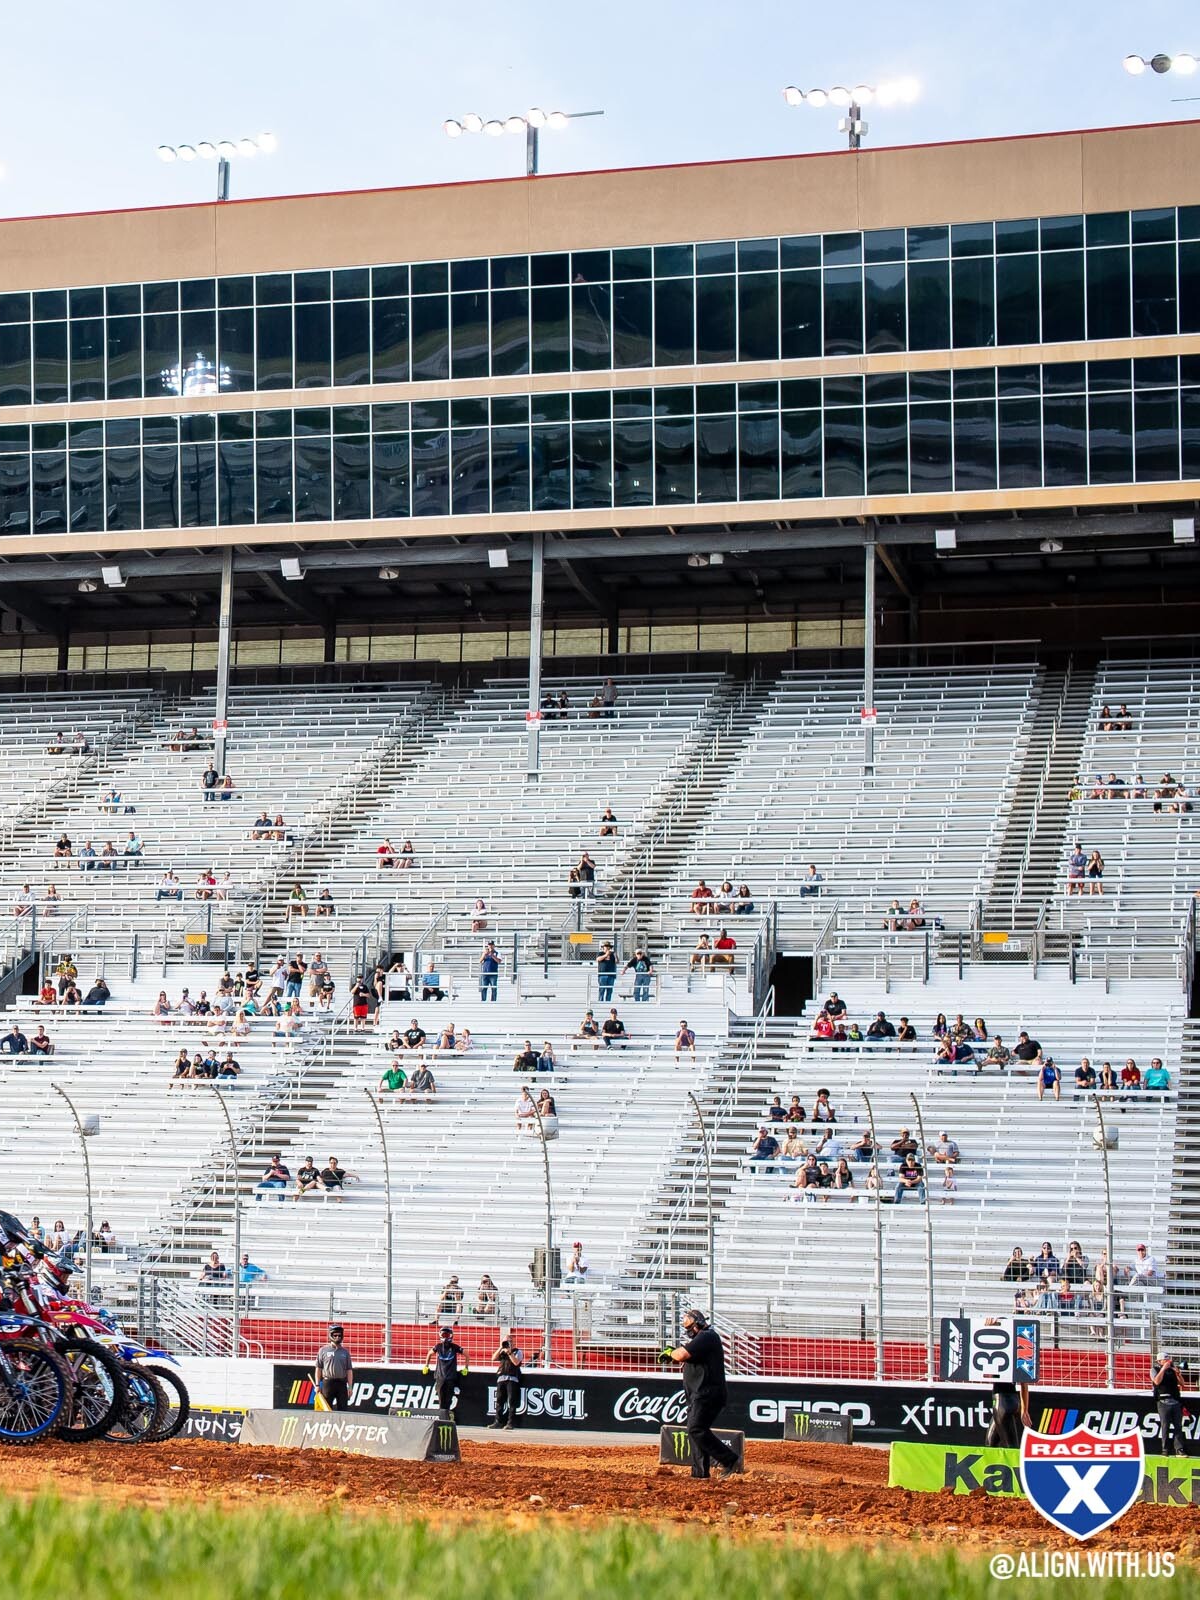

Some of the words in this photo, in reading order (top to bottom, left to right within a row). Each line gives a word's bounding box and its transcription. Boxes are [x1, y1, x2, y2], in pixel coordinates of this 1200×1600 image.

[972, 1328, 1010, 1373] 30
[613, 1387, 689, 1424] Coca-Co
[901, 1396, 994, 1435] xfinit
